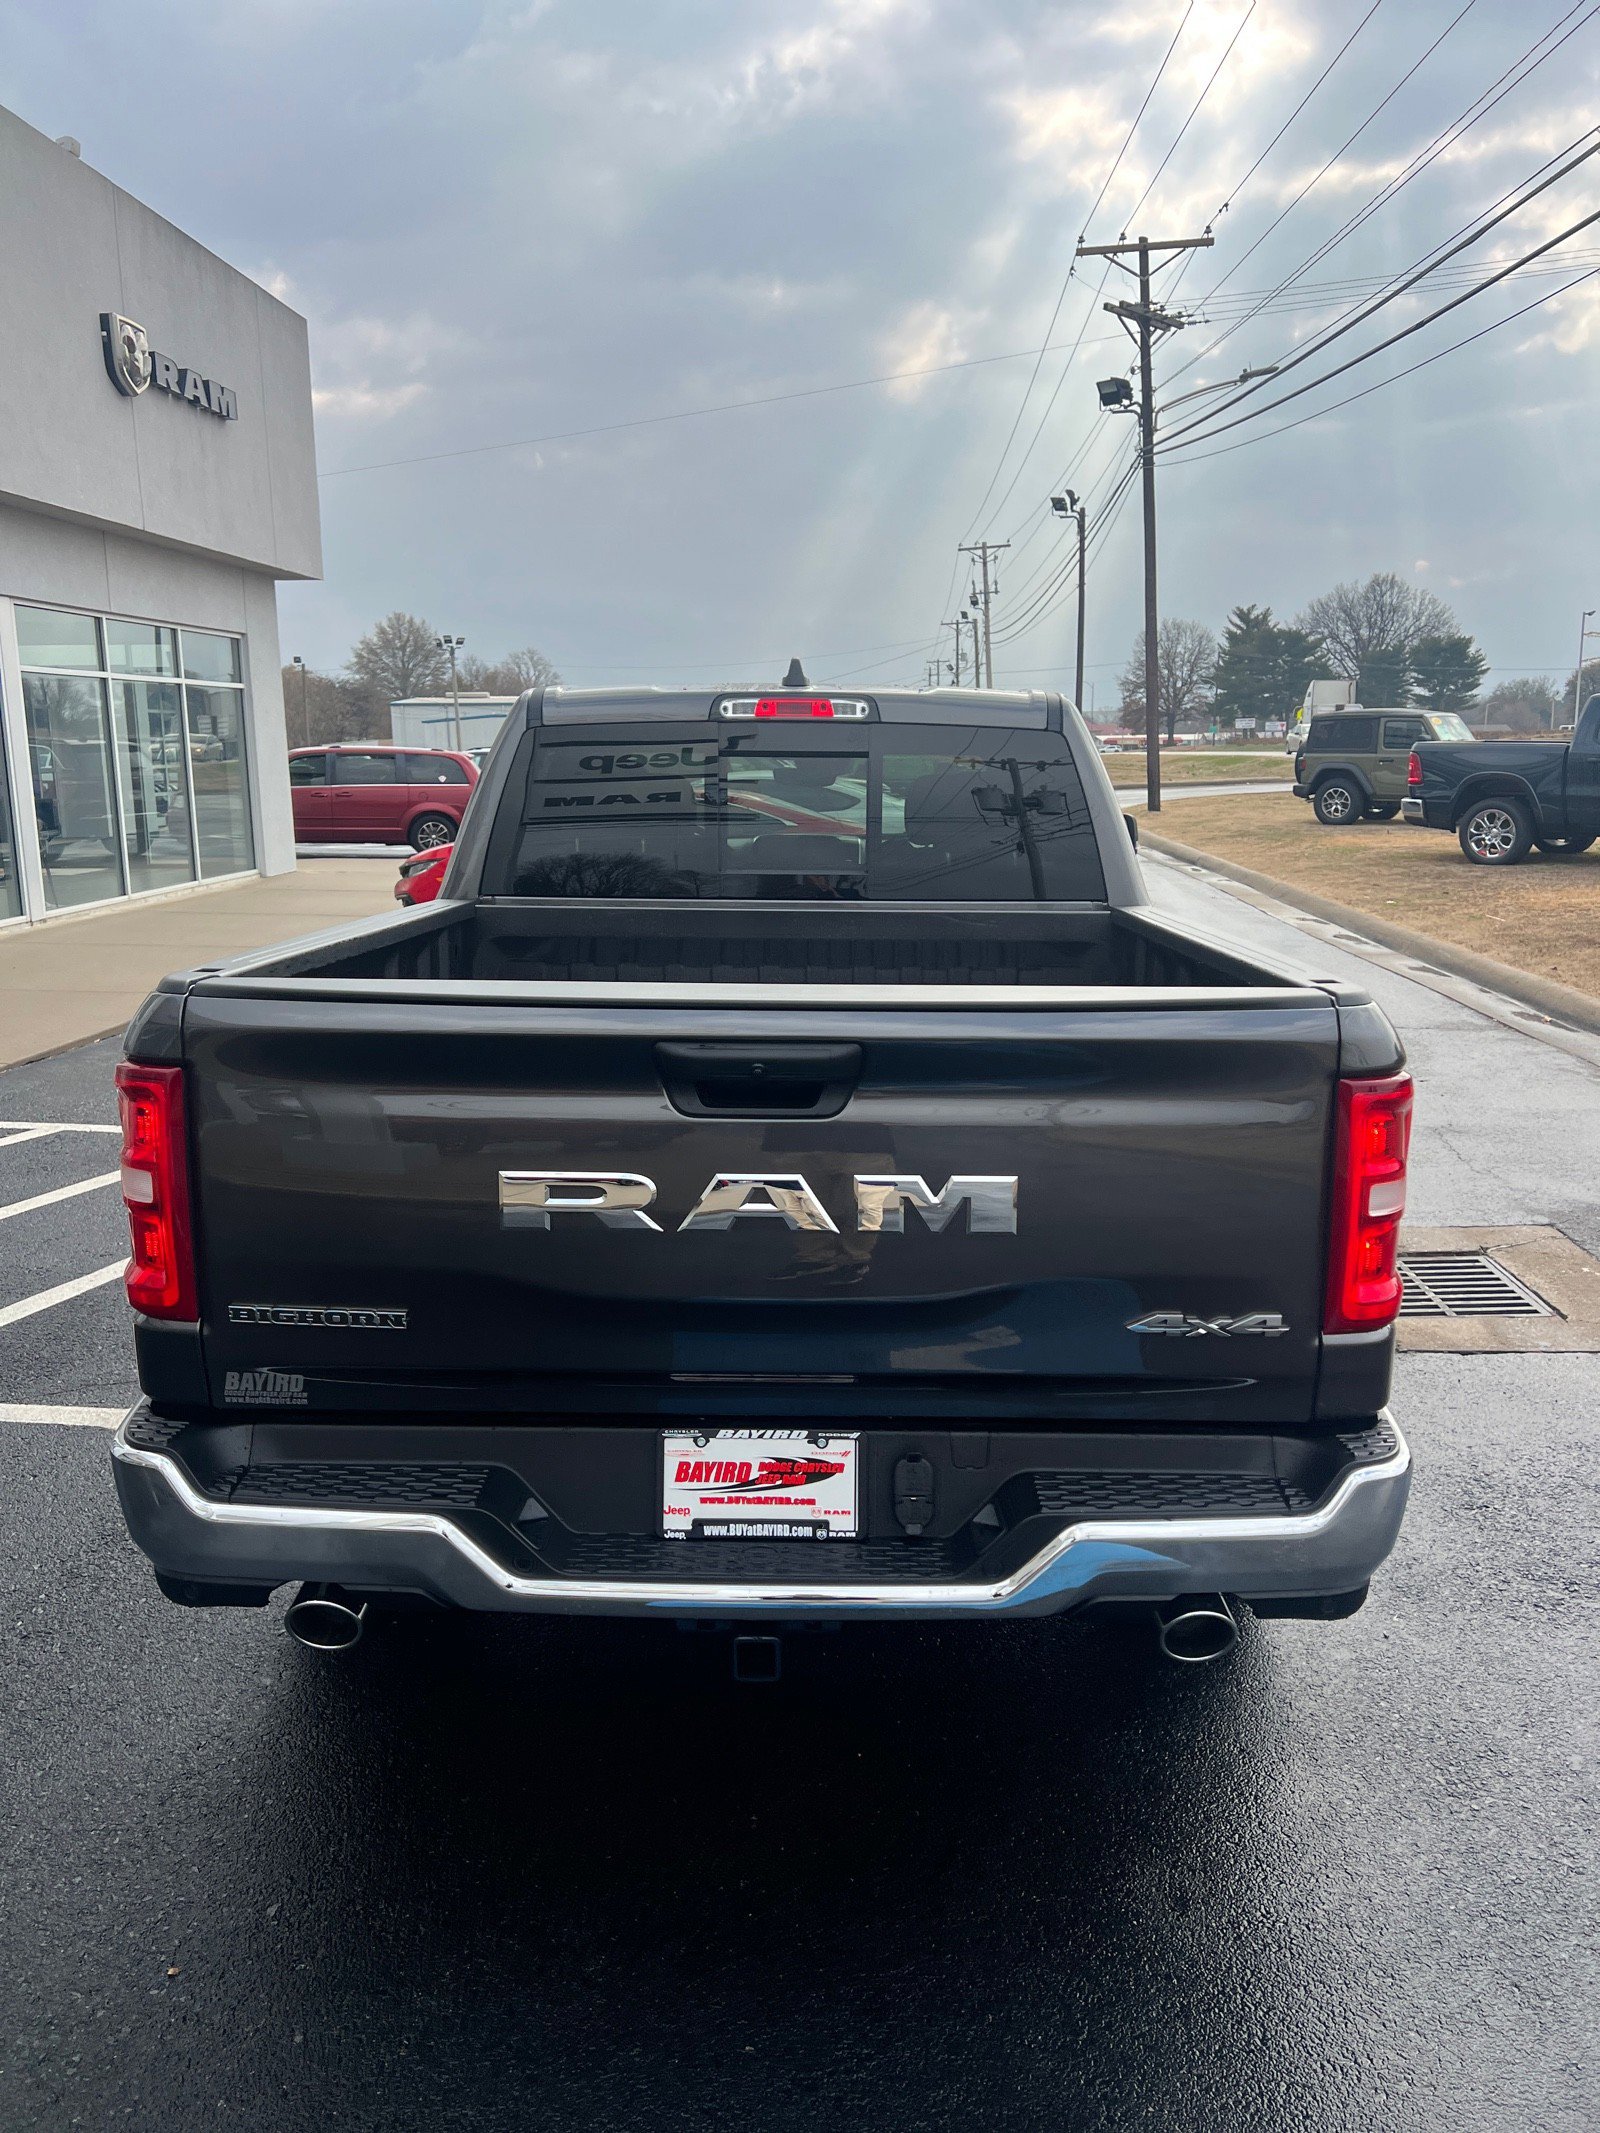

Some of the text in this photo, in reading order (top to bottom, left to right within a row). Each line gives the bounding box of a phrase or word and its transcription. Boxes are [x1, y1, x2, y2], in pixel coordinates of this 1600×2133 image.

[149, 351, 238, 420] RAM
[499, 1170, 1018, 1235] RAM
[225, 1371, 304, 1392] BAYIRD
[716, 1429, 809, 1439] BAYIRD
[675, 1461, 752, 1483] BAYIRD
[758, 1462, 845, 1474] DODGE CHRYSLER
[755, 1474, 807, 1485] JEEP RAM
[699, 1496, 816, 1506] www.BUYatBAYIRD.com
[664, 1505, 691, 1517] Jeep
[704, 1524, 813, 1537] www.BUYatBAYIRD.com
